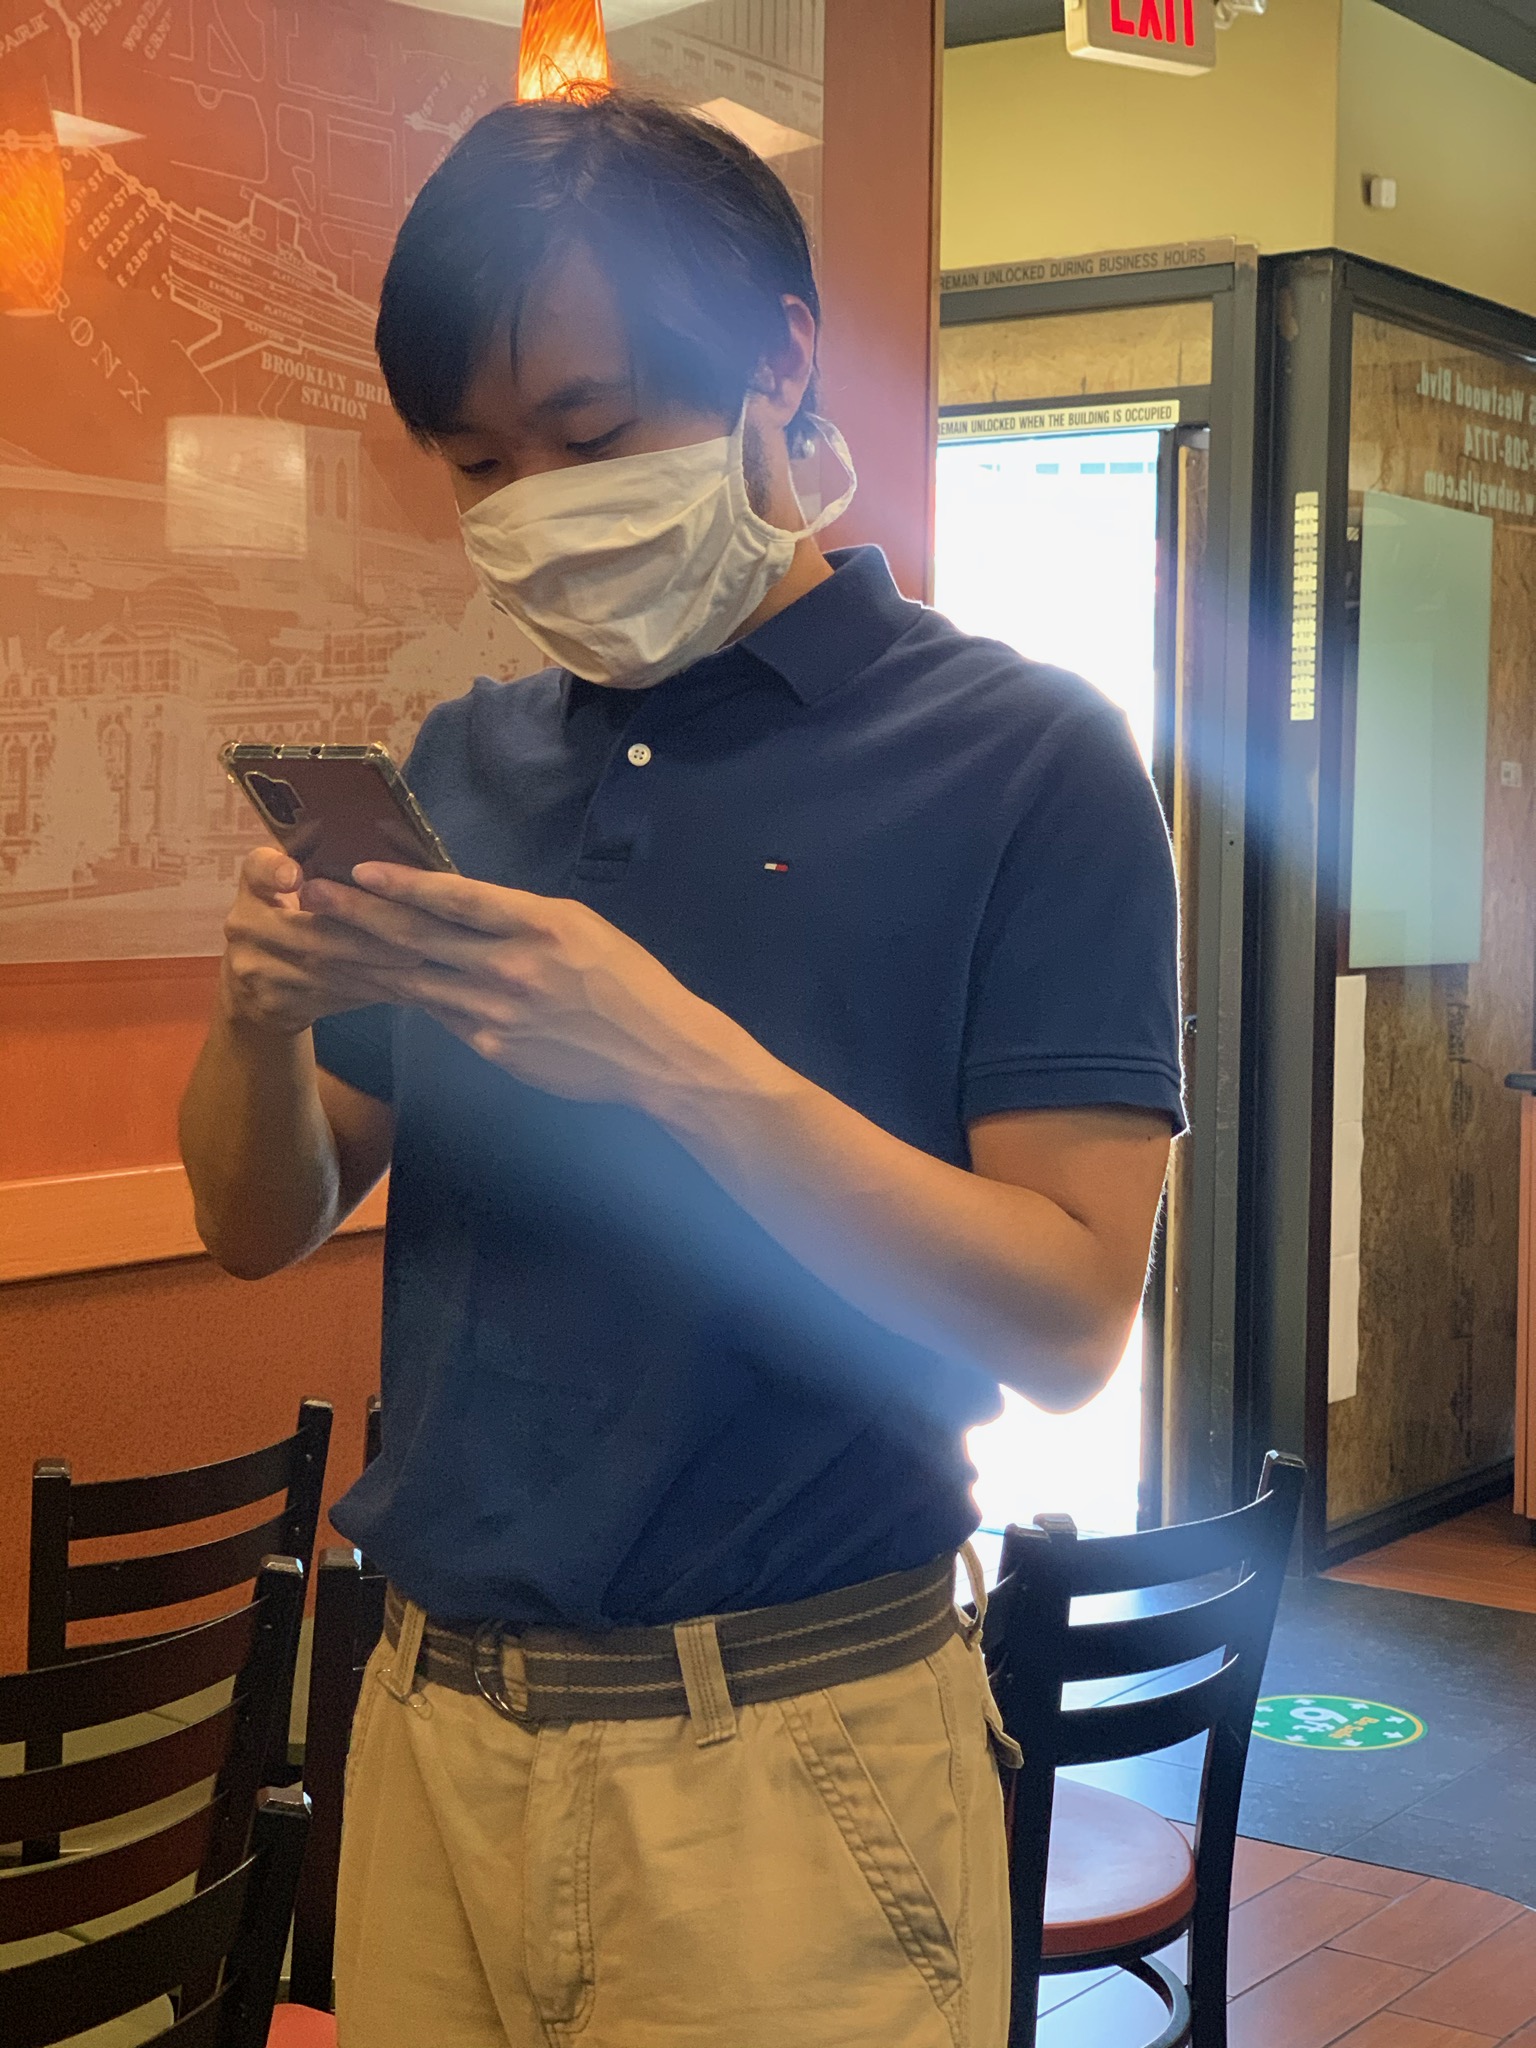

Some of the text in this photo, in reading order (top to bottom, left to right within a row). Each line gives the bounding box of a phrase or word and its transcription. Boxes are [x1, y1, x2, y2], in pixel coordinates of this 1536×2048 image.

[983, 264, 1045, 284] UNLOCKED
[1050, 259, 1094, 278] DURING
[1099, 252, 1158, 273] BUSINESS
[1164, 248, 1206, 265] HOURS
[261, 351, 348, 392] BROOKLYN
[300, 385, 368, 421] STATION
[970, 418, 1015, 434] UNLOCKED
[1019, 415, 1045, 429] WHEN
[1048, 413, 1065, 427] THE
[1068, 411, 1110, 425] BUILDING
[1113, 409, 1122, 423] IS
[1125, 406, 1172, 422] OCCUPIED
[1289, 1706, 1349, 1733] 6ft
